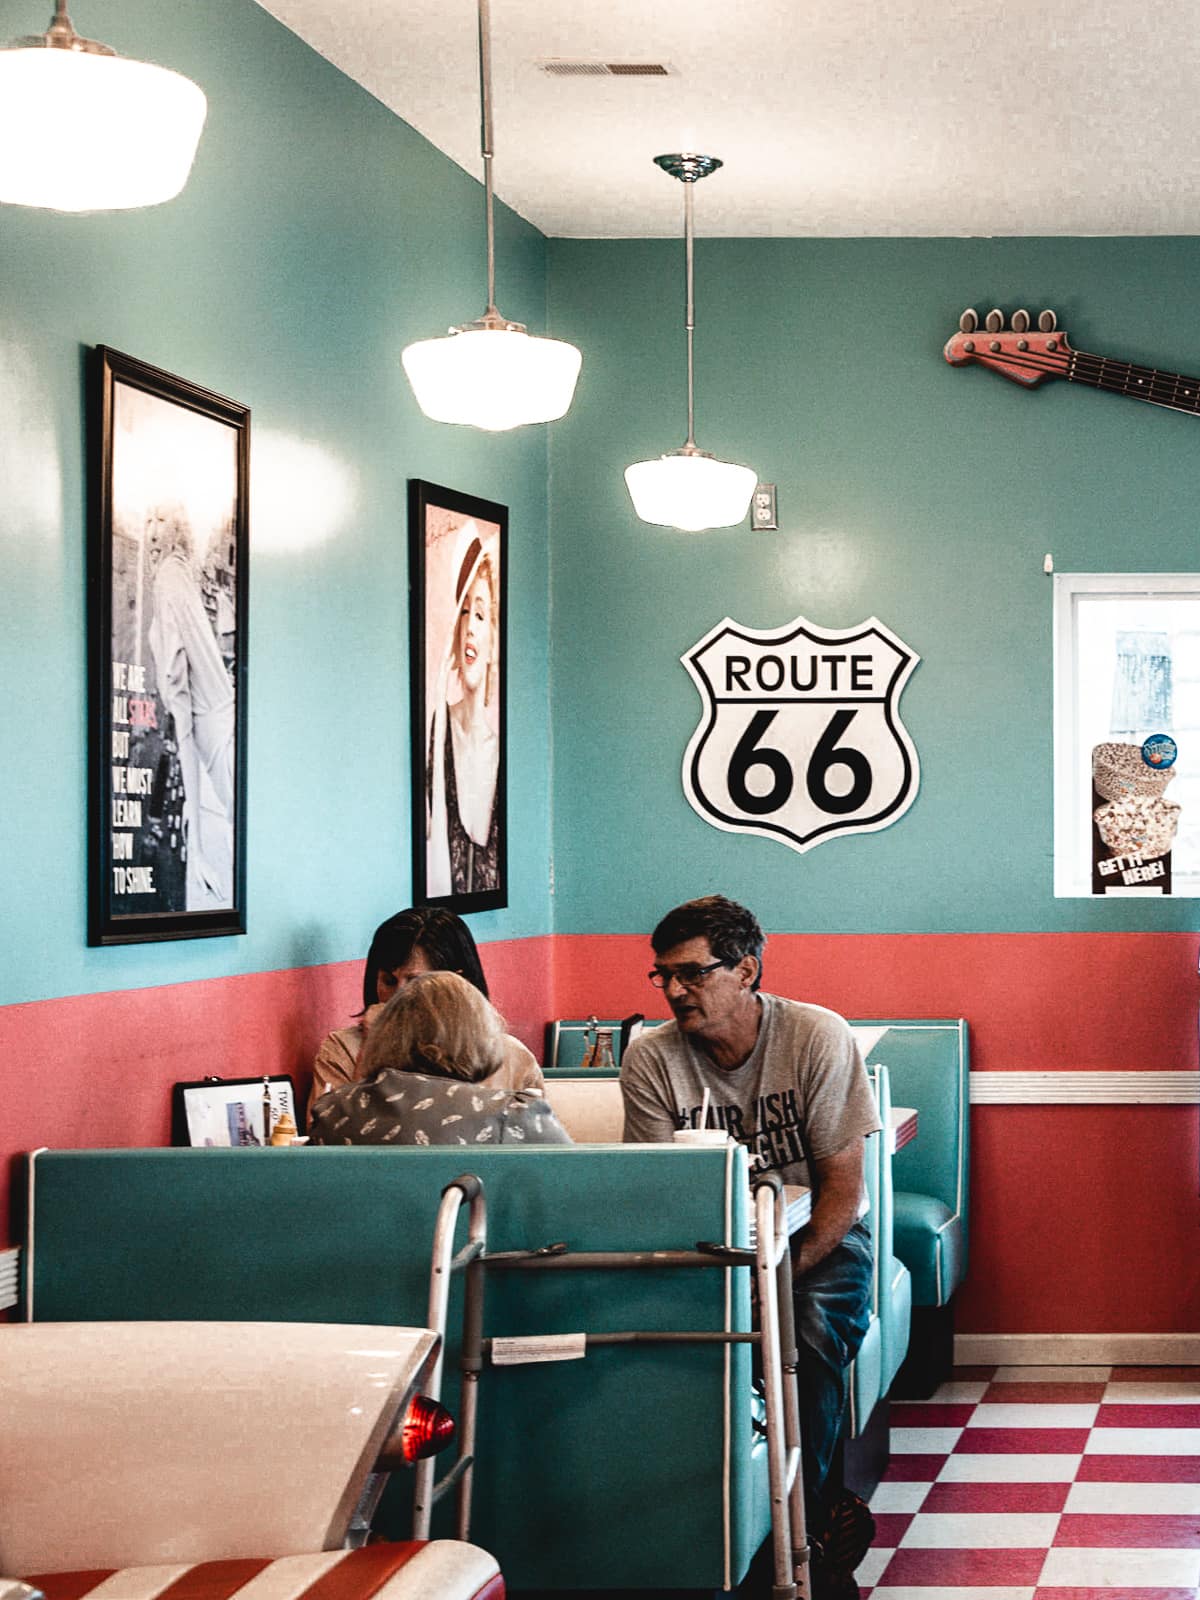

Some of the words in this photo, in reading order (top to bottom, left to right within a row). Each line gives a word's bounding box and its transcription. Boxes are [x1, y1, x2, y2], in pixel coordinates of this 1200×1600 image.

[112, 661, 128, 690] WE
[128, 664, 146, 693] ARE
[725, 655, 873, 692] ROUTE
[112, 695, 129, 724] ALL
[112, 730, 131, 758] BUT
[727, 710, 873, 815] 66
[112, 765, 127, 794] WE
[127, 767, 153, 795] MUST
[112, 799, 142, 827] LEARN
[112, 833, 134, 860] HOW
[1097, 855, 1125, 876] GET
[1126, 851, 1144, 868] IT
[1121, 860, 1166, 885] HERE!
[113, 866, 126, 895] TO
